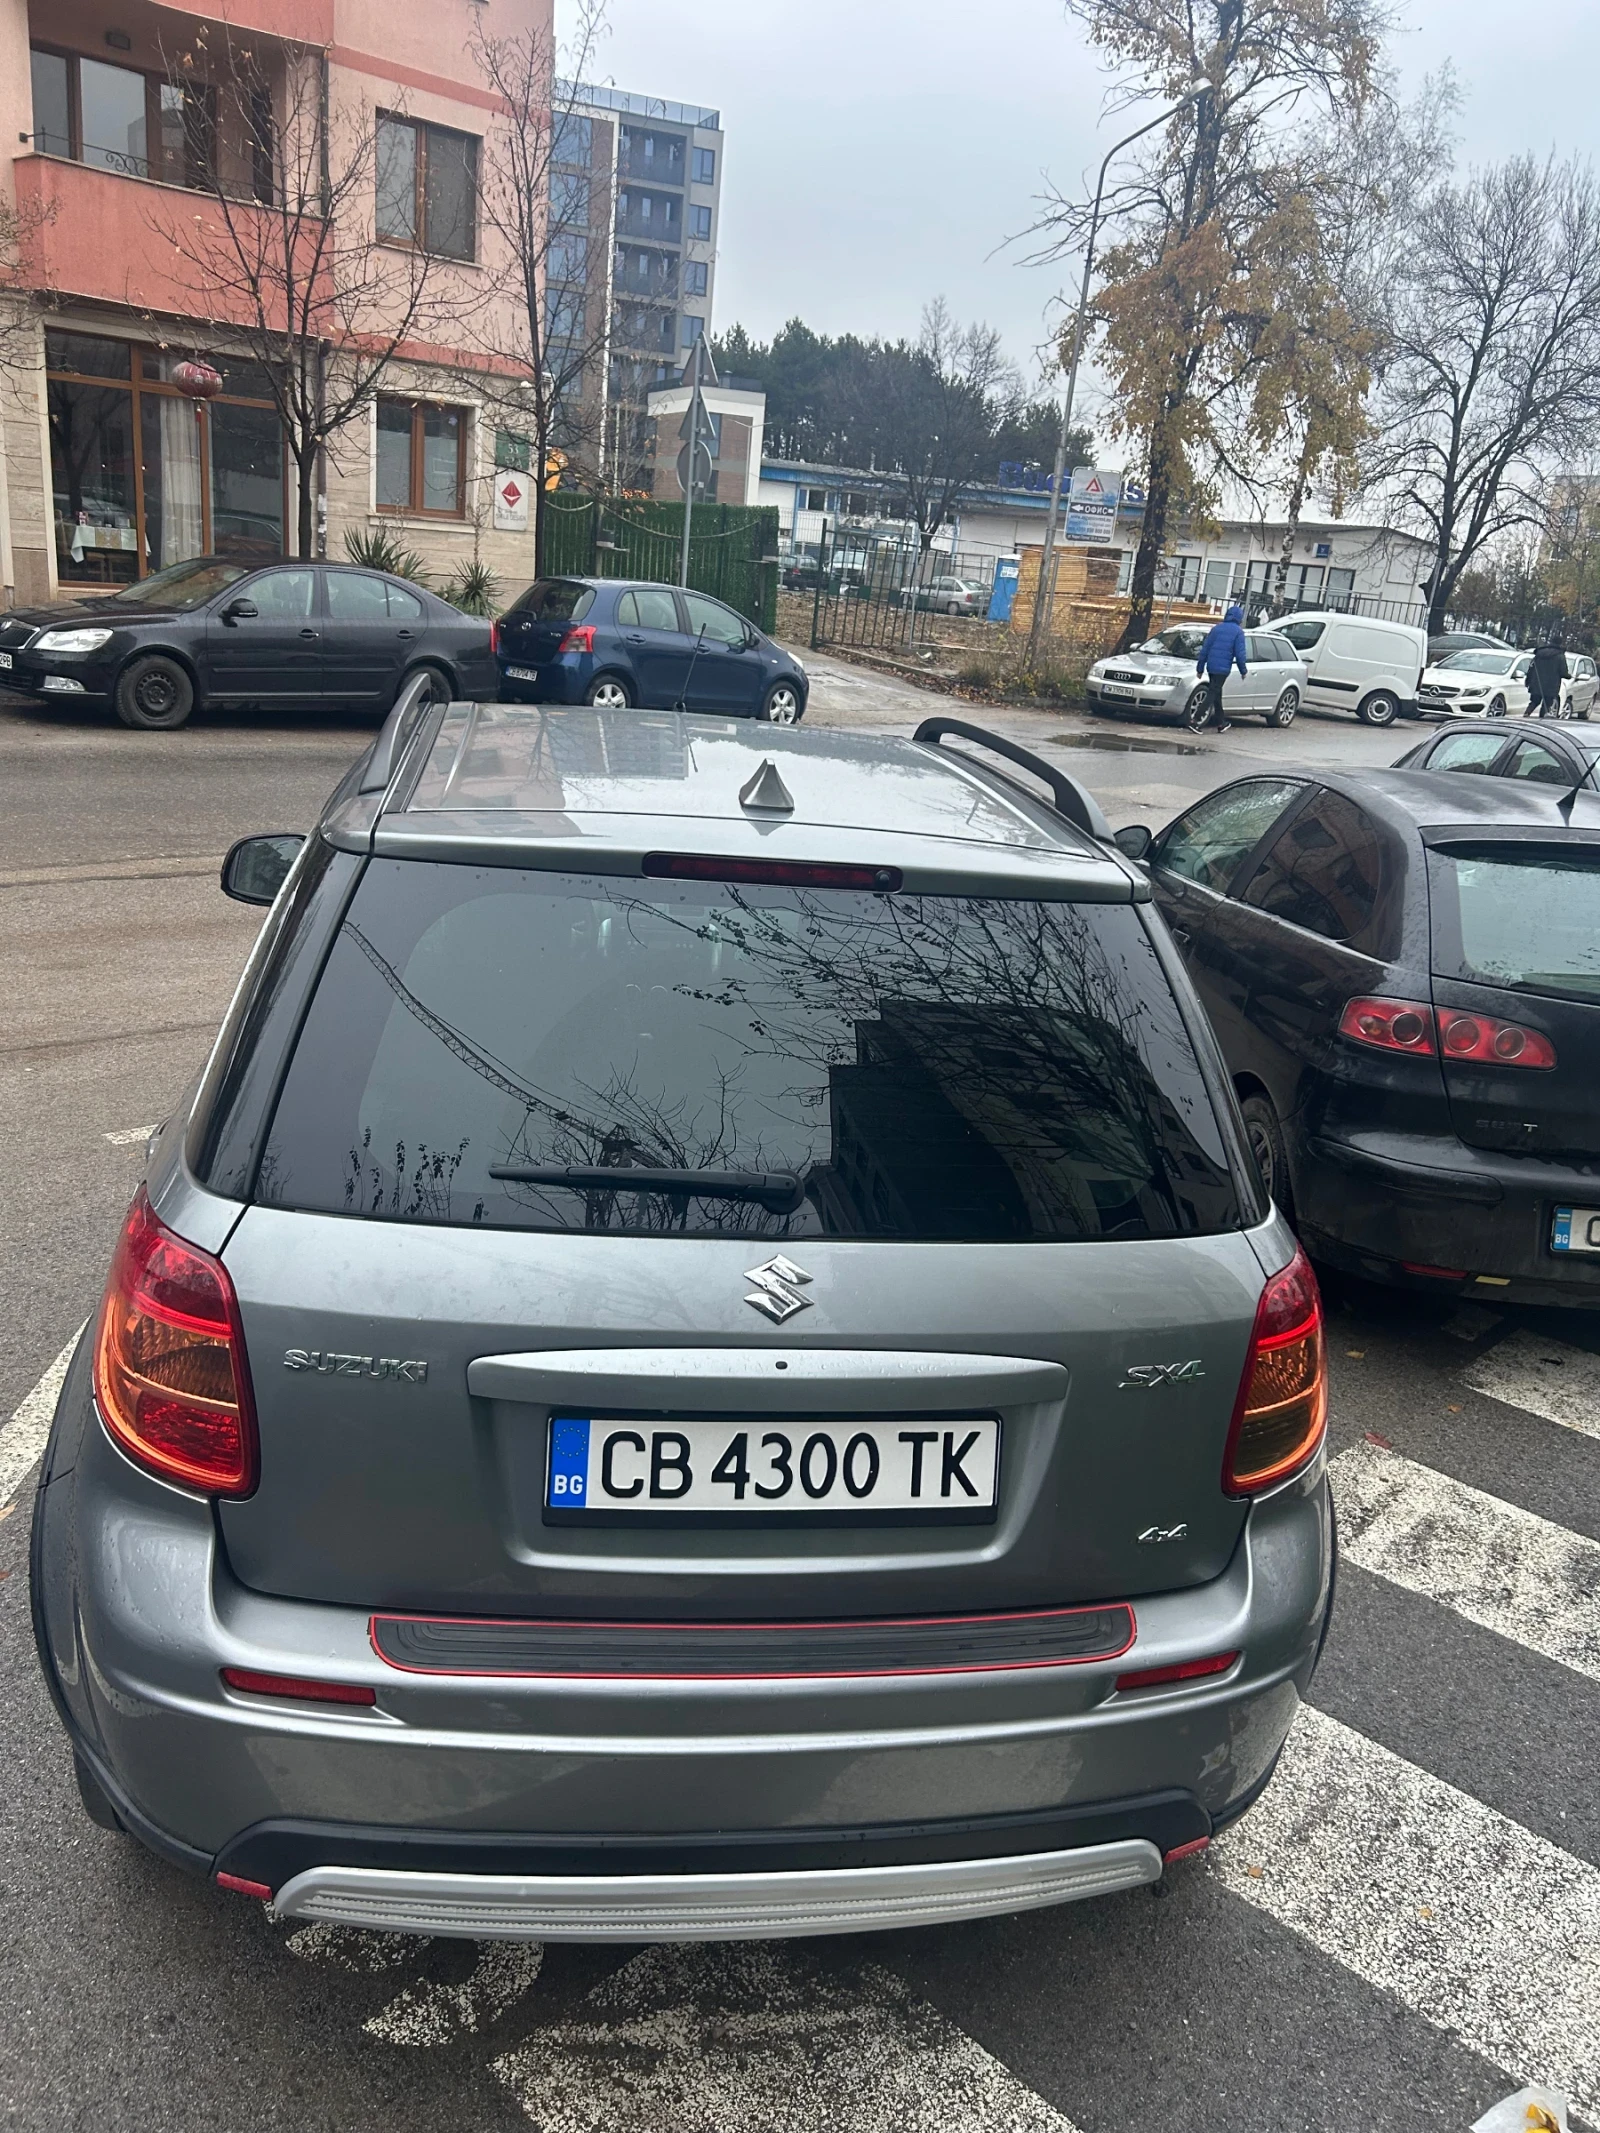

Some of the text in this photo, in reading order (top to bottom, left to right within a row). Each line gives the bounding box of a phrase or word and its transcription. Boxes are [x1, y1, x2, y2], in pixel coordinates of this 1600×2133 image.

[508, 443, 519, 454] 53
[1084, 505, 1108, 515] ОФИС
[1555, 1233, 1569, 1244] BG
[283, 1349, 428, 1383] SUZUKI
[1118, 1359, 1206, 1388] SX4
[554, 1431, 981, 1500] BG CB 4300 TK
